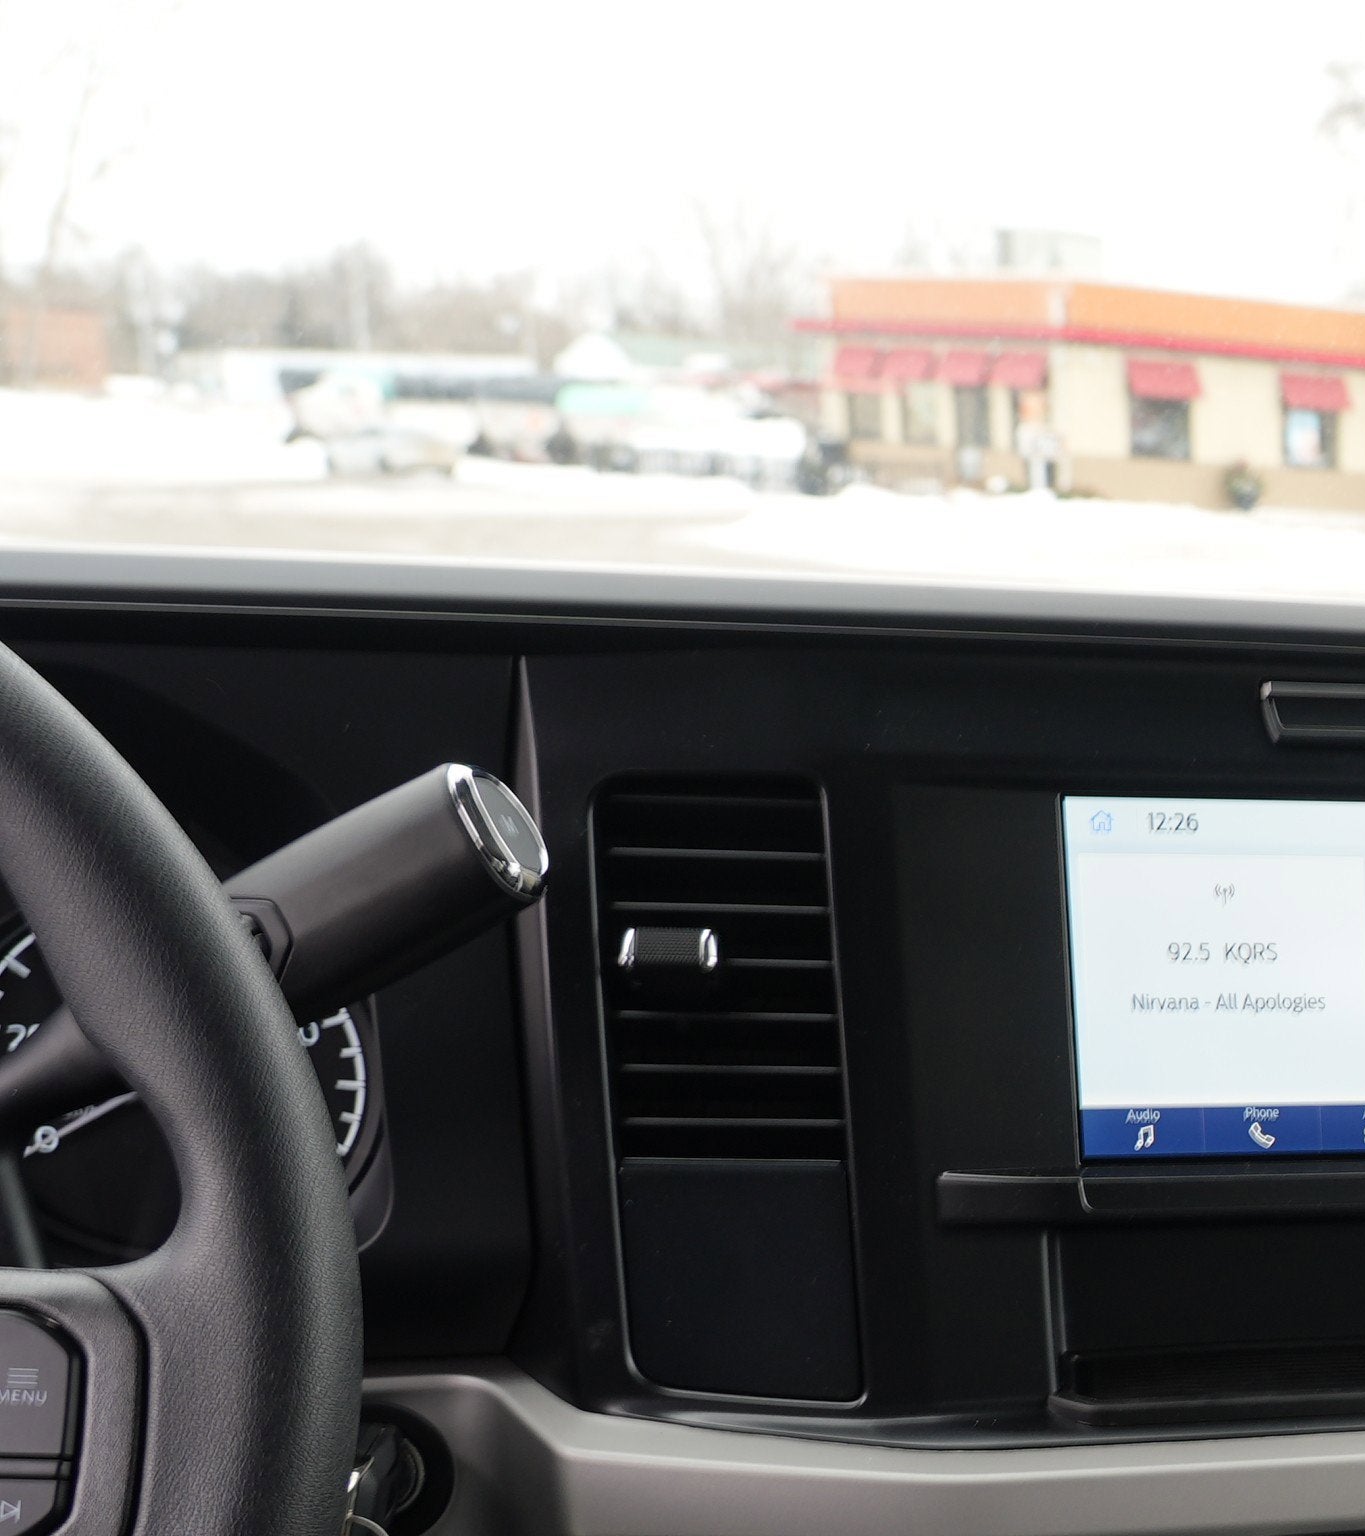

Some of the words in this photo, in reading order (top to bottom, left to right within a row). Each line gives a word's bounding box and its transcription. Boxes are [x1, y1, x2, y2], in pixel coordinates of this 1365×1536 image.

[1147, 811, 1199, 832] 12:26
[1167, 942, 1211, 962] 92.5
[1223, 942, 1278, 963] KQRS
[1131, 993, 1200, 1011] Nirvana
[1215, 993, 1238, 1011] All
[1242, 992, 1327, 1013] Apologies
[1127, 1108, 1161, 1123] Audio
[1244, 1106, 1280, 1121] Phone
[0, 1389, 48, 1408] MENU
